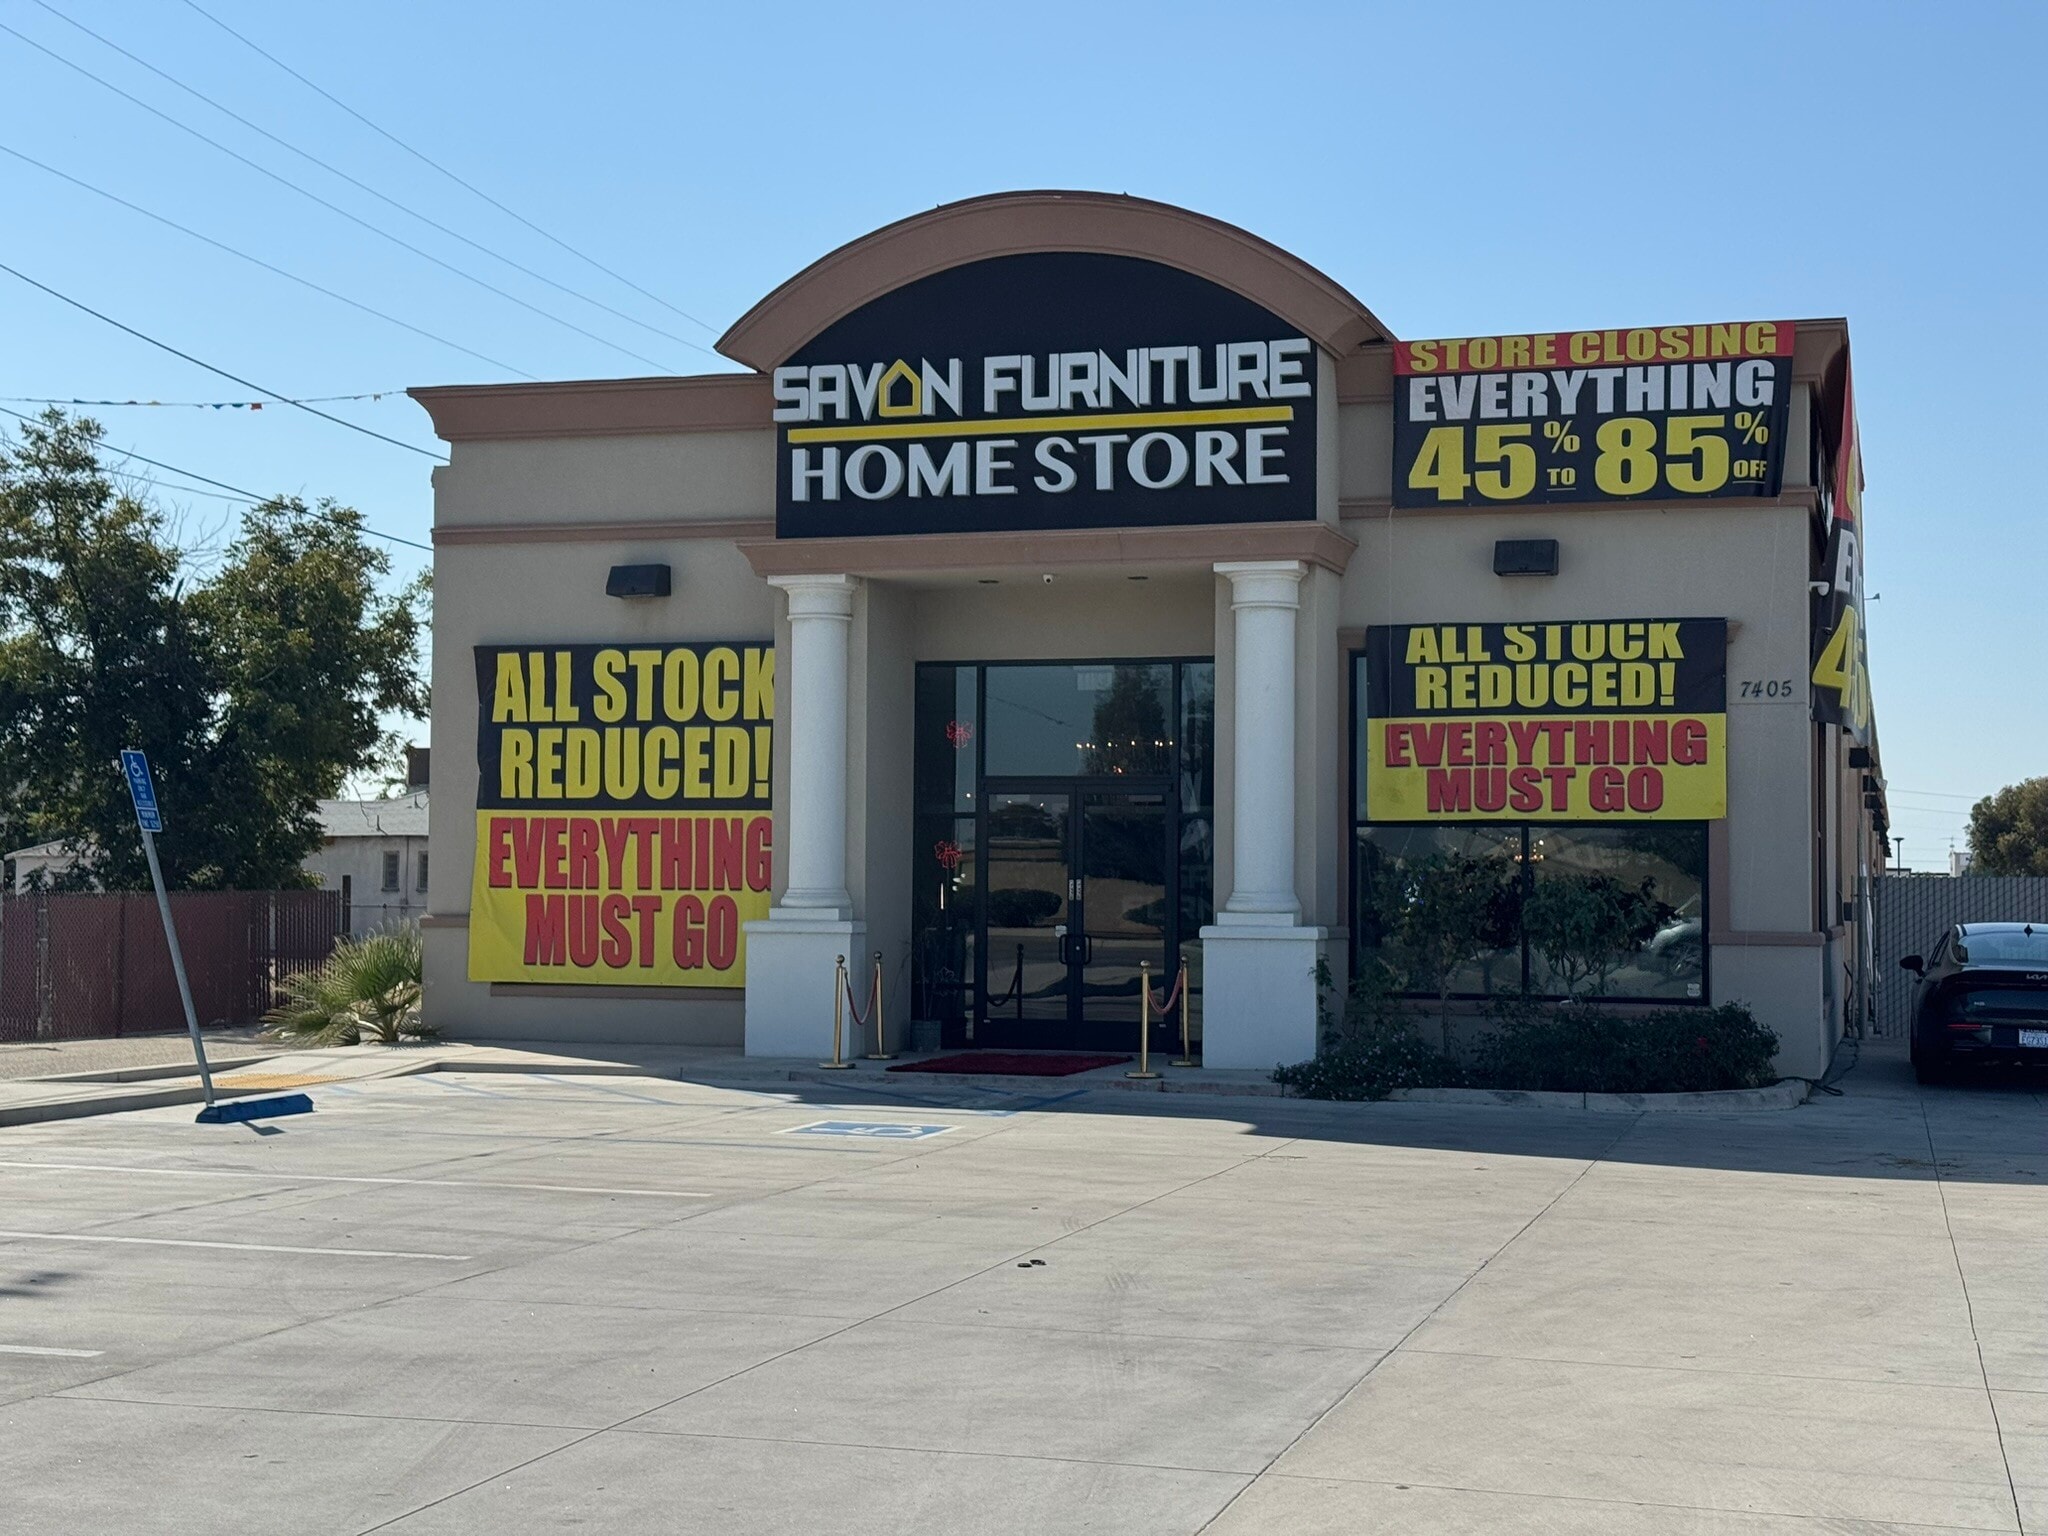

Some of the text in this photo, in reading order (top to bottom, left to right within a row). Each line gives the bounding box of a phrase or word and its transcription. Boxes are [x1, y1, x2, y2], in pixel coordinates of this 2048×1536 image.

[983, 337, 1312, 412] FURNITURE
[1410, 322, 1777, 372] STORE CLOSING
[1409, 359, 1775, 422] EVERYTHING
[791, 426, 1290, 501] HOME STORE
[1547, 467, 1576, 485] TO
[1733, 460, 1767, 478] OFF
[1405, 626, 1491, 663] ALL
[492, 647, 775, 722] ALL STOCK
[1415, 662, 1676, 709] REDUCED!
[1741, 680, 1792, 697] 7405
[500, 726, 772, 799] REDUCED!
[1385, 718, 1708, 767] EVERYTHING
[1426, 766, 1664, 812] MUST GO
[489, 816, 772, 891] EVERYTHING
[524, 894, 738, 970] MUST GO
